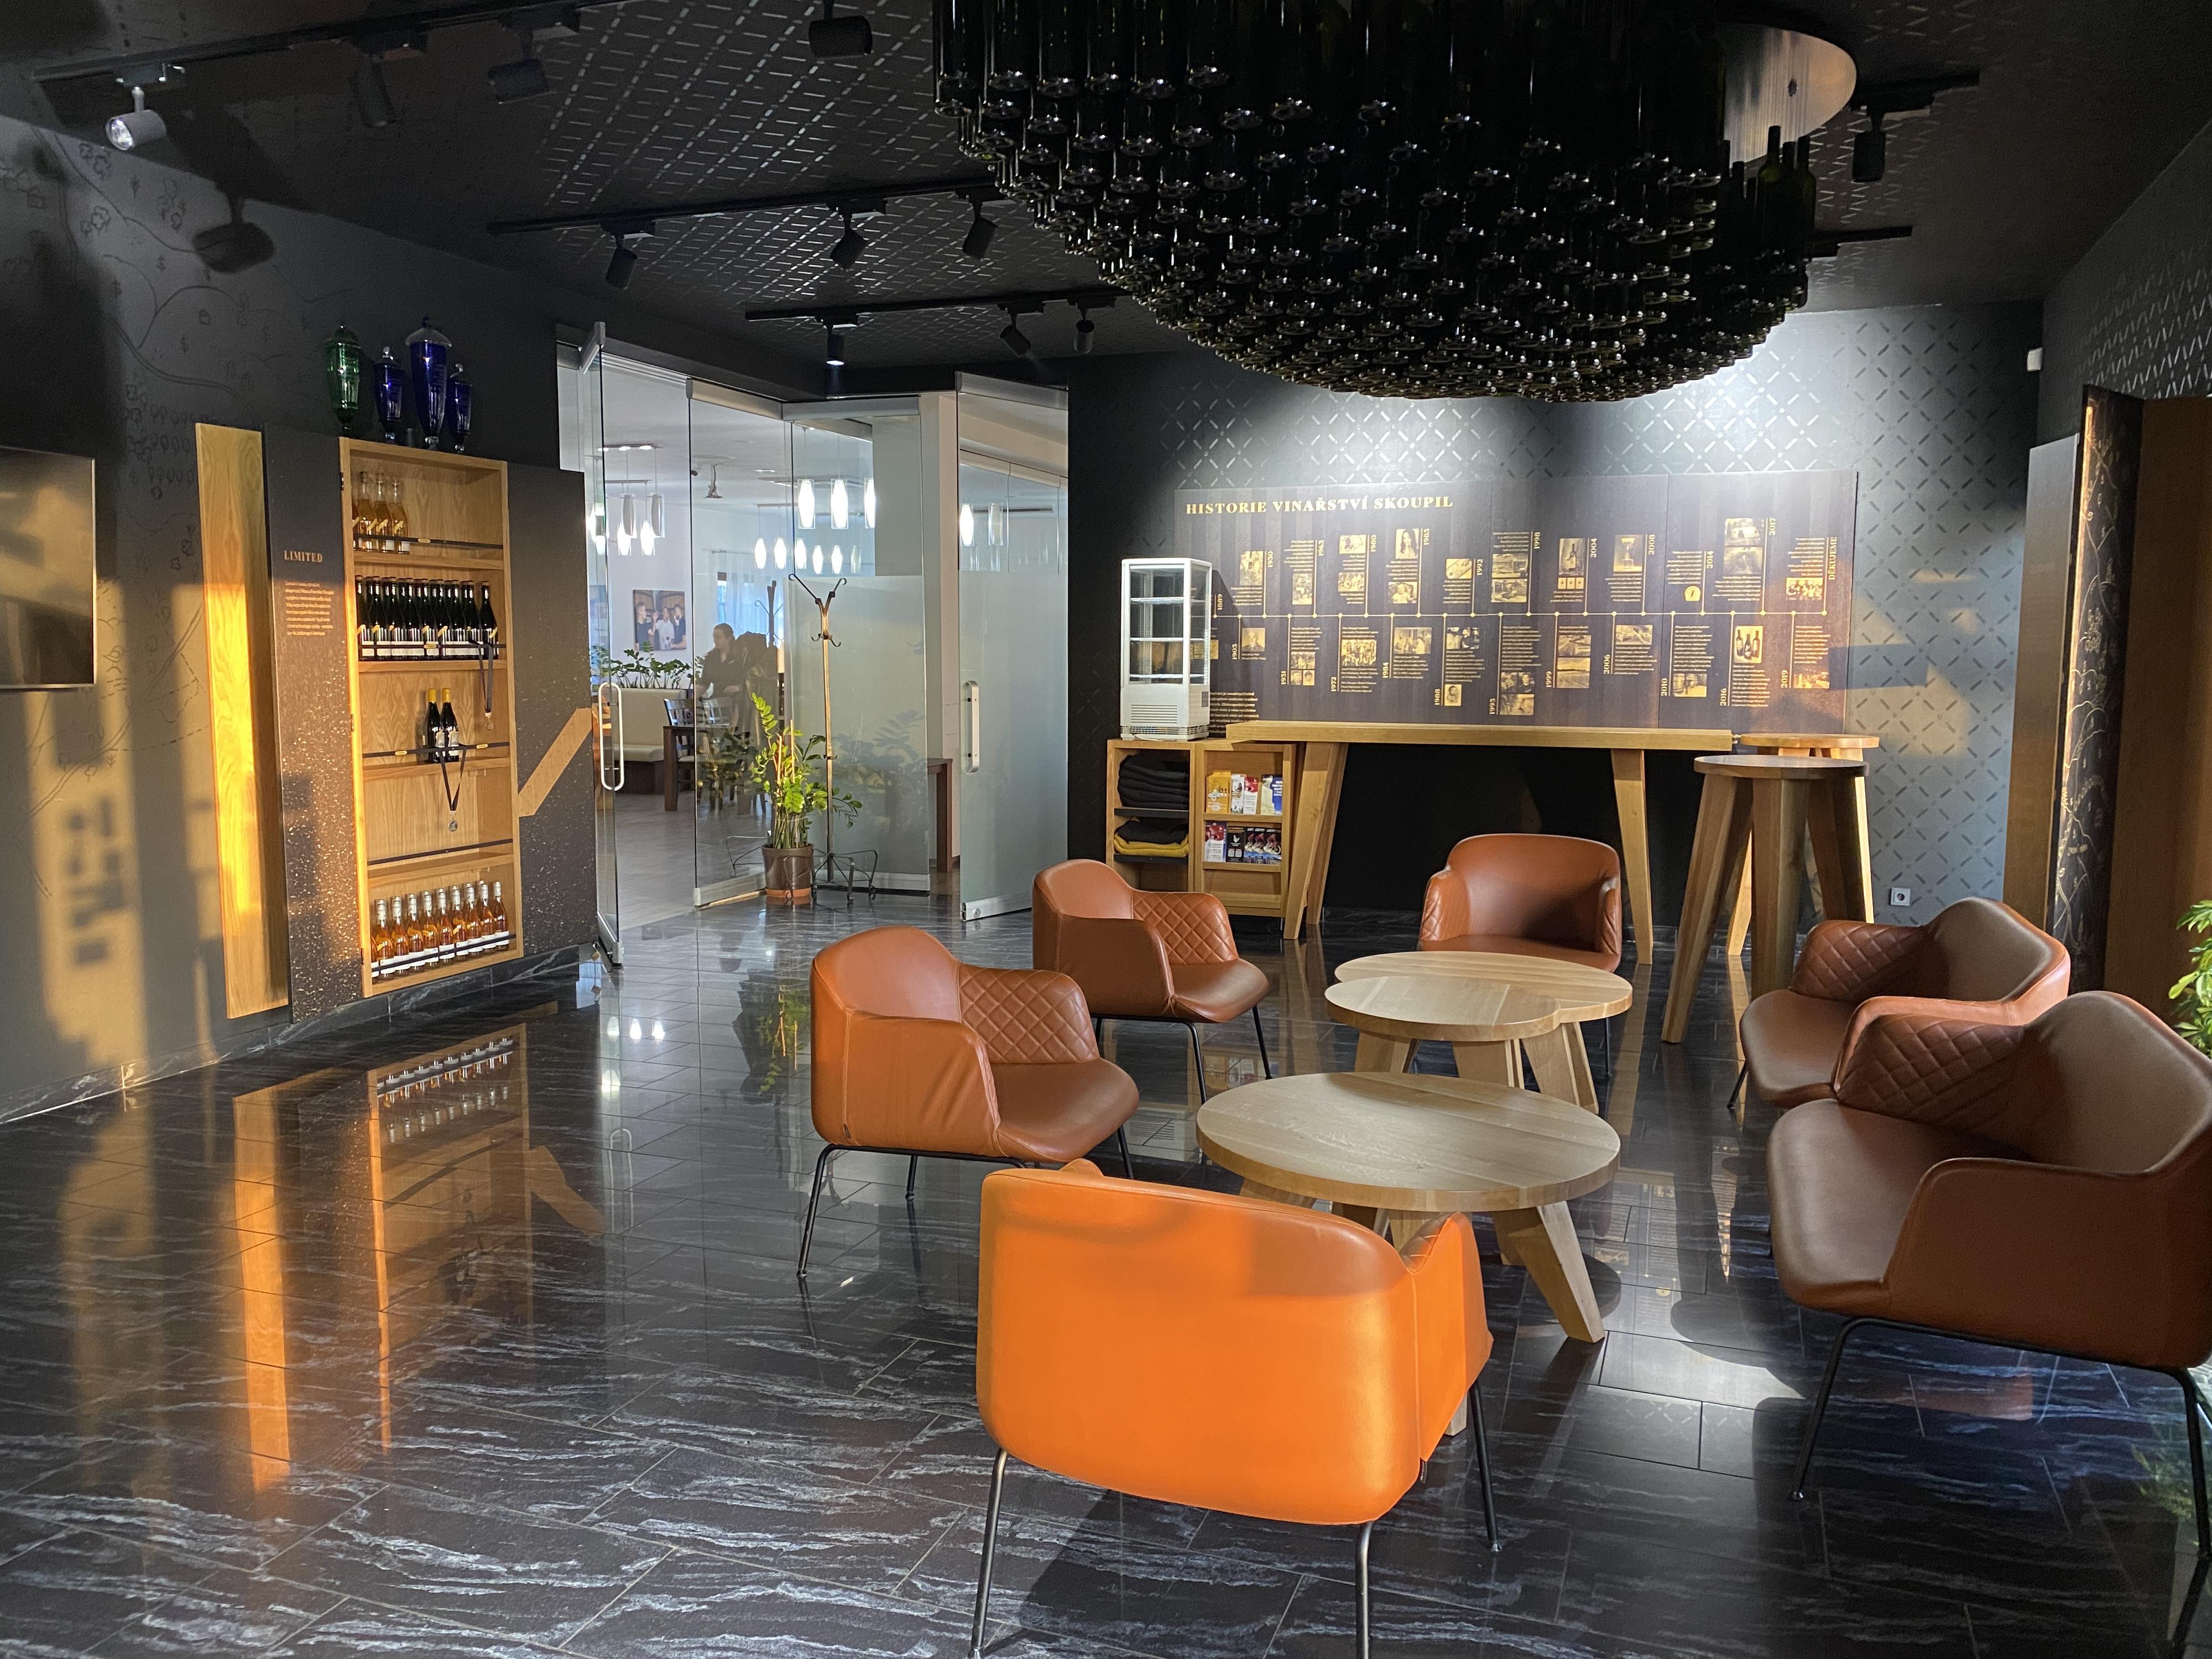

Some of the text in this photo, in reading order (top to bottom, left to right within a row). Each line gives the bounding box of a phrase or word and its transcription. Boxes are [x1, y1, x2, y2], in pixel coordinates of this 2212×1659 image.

[1186, 495, 1453, 514] HISTORIE VINAŘSTVÍ SKOUPIL
[284, 550, 322, 562] LIMITED
[1828, 536, 1837, 580] DĚKUJEME
